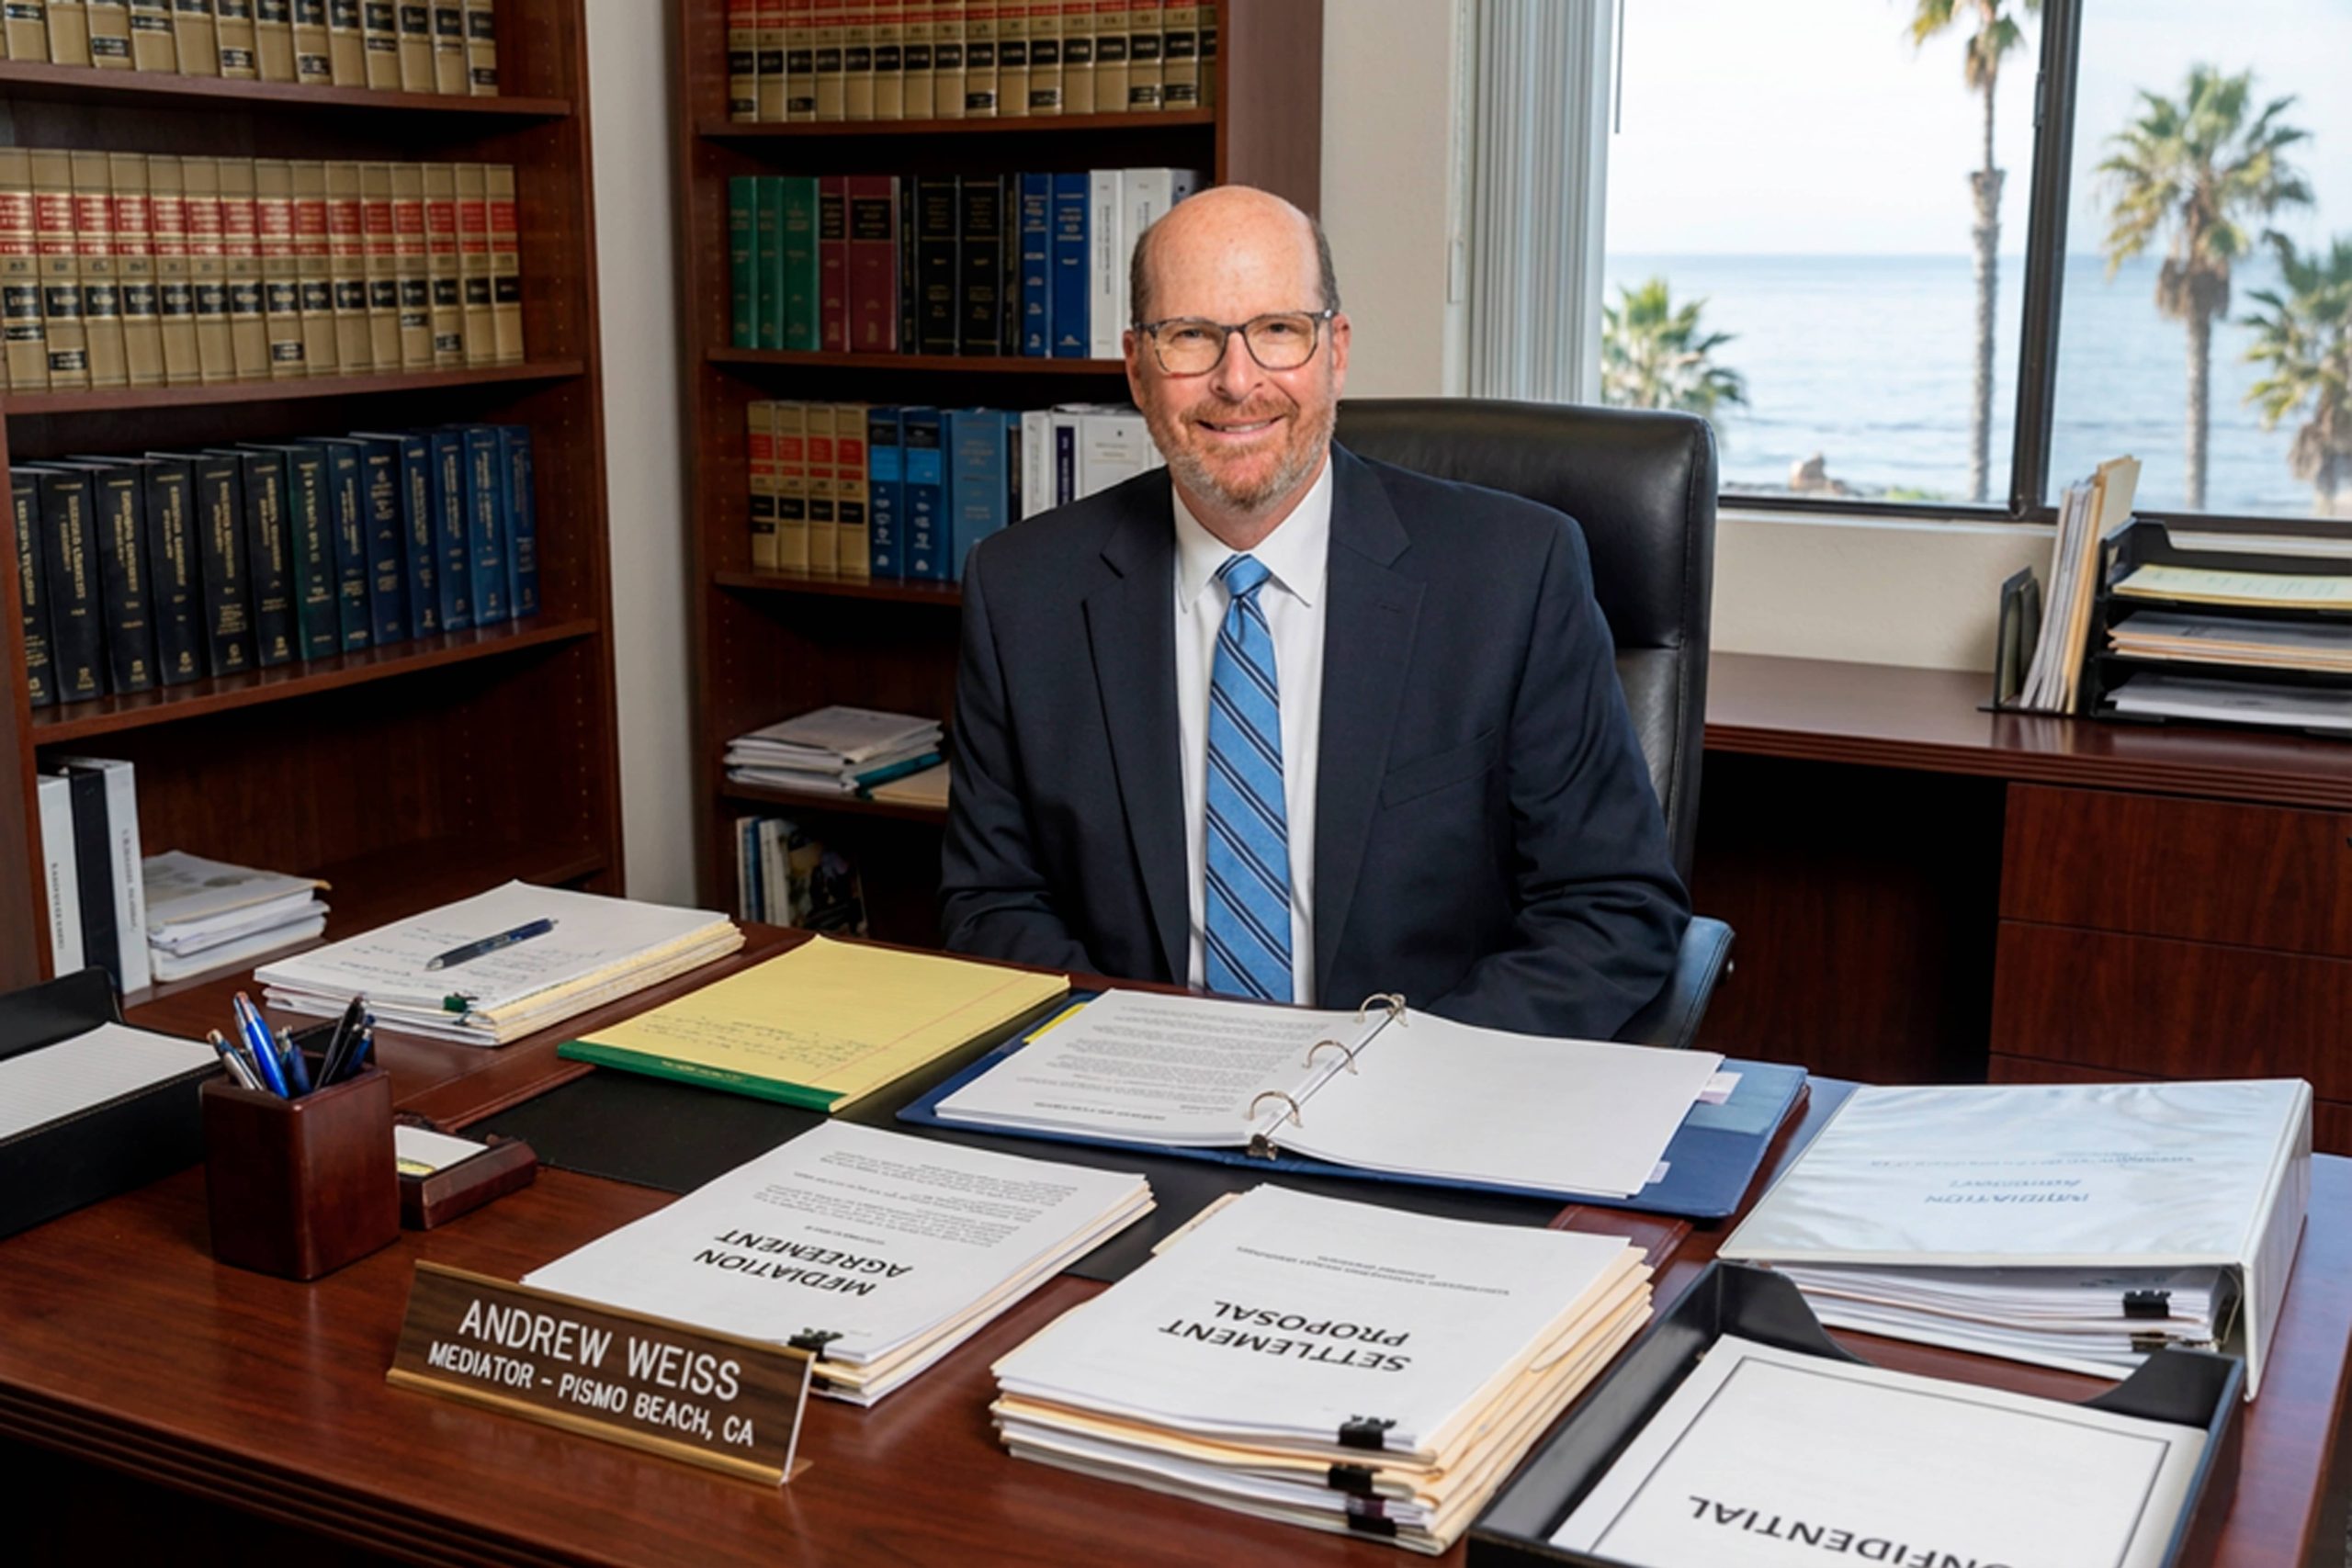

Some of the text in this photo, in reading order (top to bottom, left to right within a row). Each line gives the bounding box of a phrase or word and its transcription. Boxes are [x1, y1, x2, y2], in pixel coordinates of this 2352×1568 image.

[693, 1248, 877, 1296] MEDIATION
[714, 1229, 913, 1278] AGREEMENT
[1158, 1318, 1412, 1372] SETTLEMENT
[1214, 1300, 1410, 1348] PROPOSAL
[458, 1299, 741, 1401] ANDREW WEISS
[427, 1341, 536, 1390] MEDIATOR
[558, 1372, 628, 1414] PISMO
[632, 1392, 714, 1441] BEACH,
[722, 1416, 755, 1447] CA
